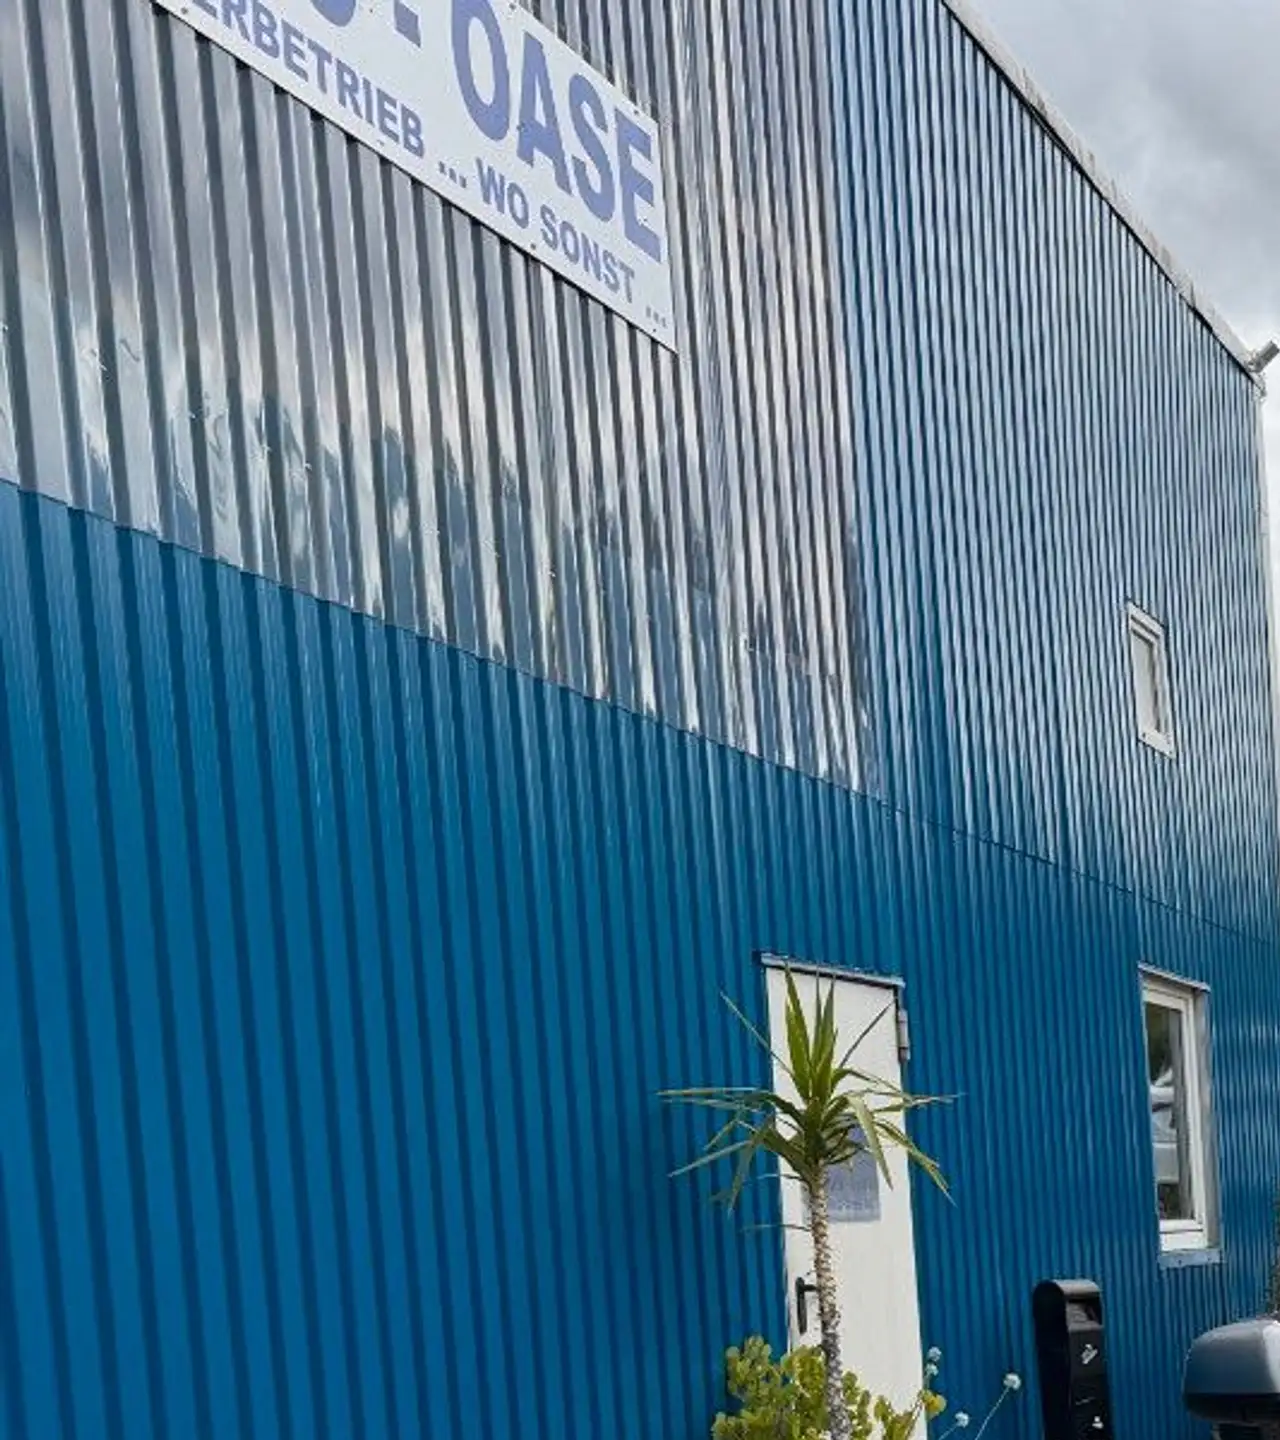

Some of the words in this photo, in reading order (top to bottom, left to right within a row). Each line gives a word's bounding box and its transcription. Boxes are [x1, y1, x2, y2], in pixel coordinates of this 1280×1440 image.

[450, 0, 661, 263] OASE
[476, 157, 529, 230] WO
[540, 204, 635, 303] SONST
